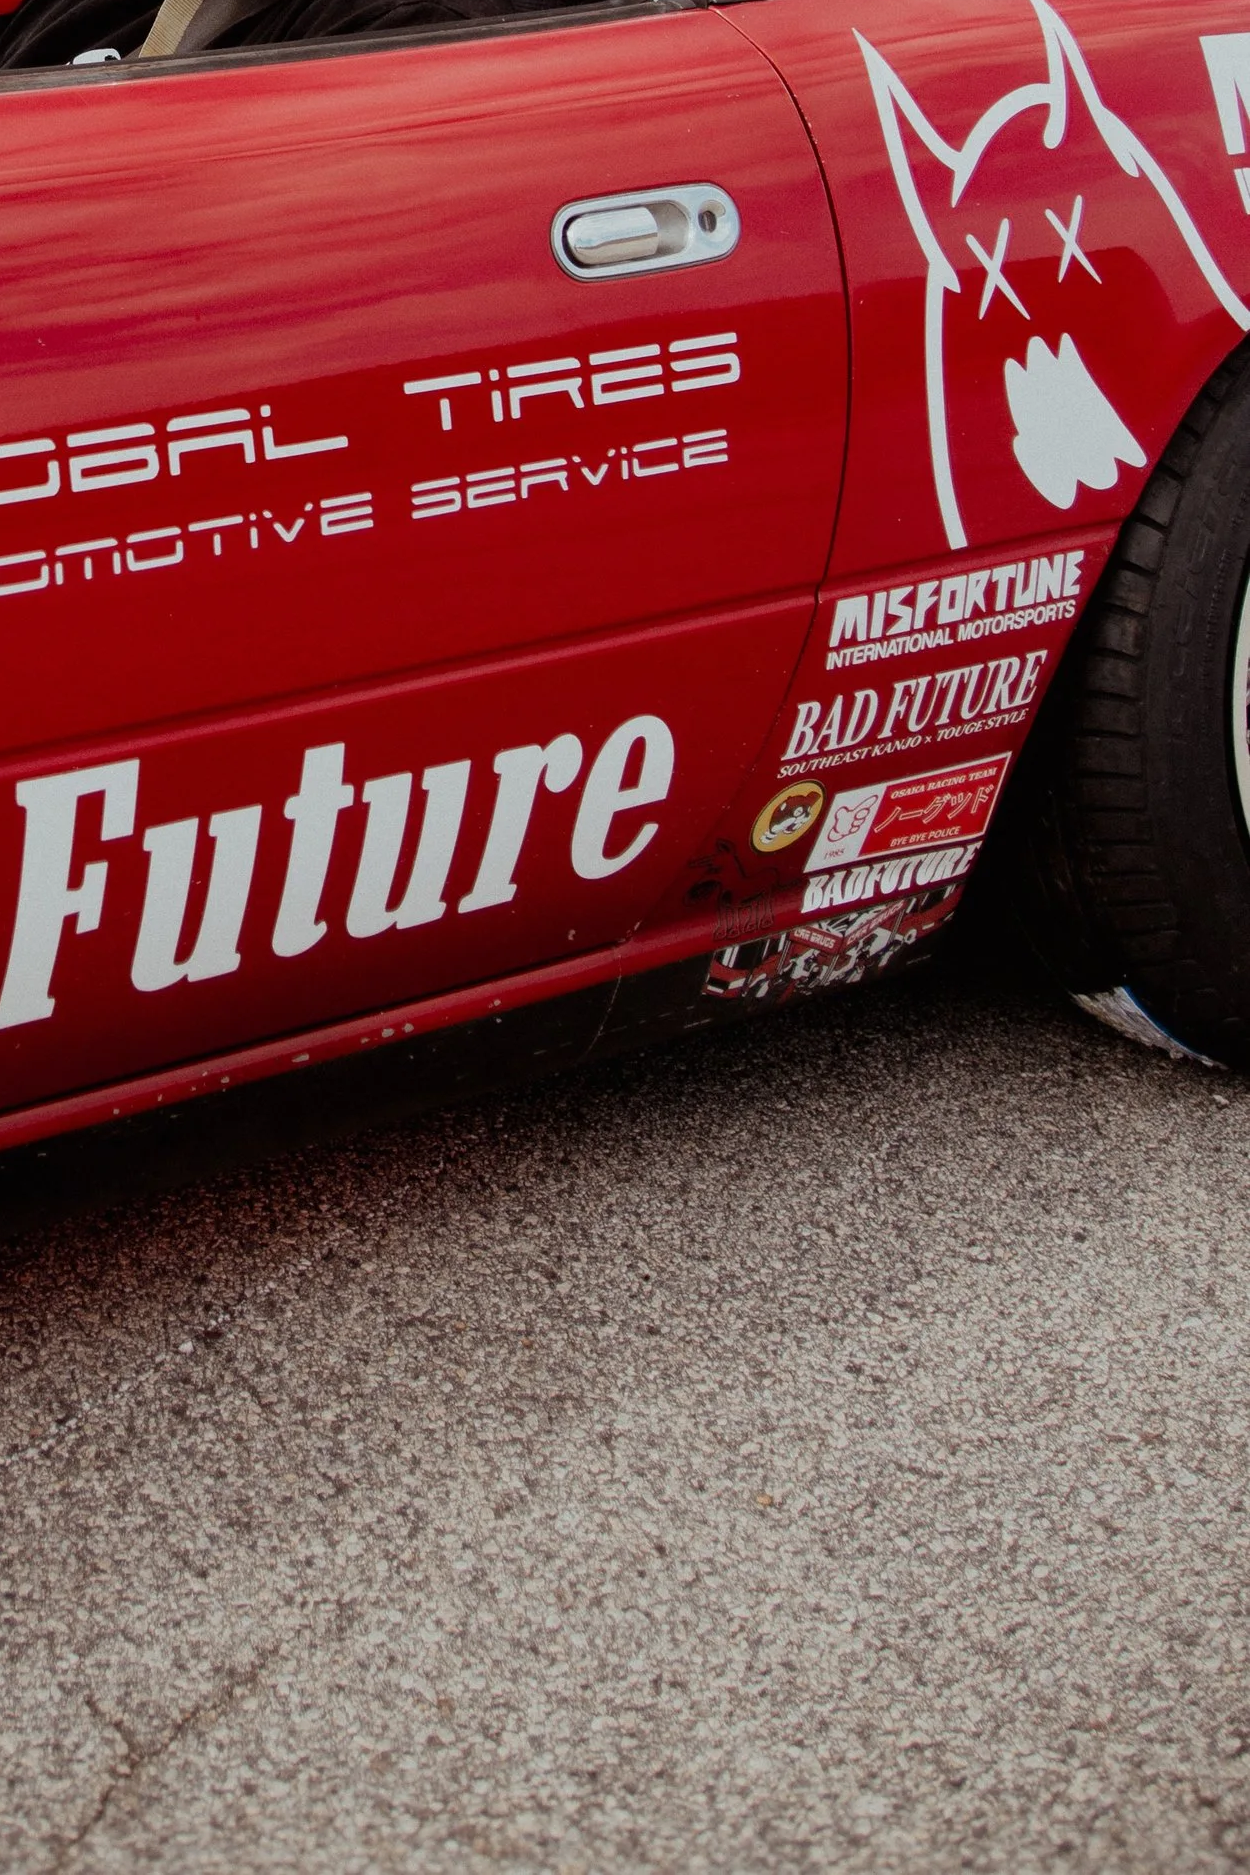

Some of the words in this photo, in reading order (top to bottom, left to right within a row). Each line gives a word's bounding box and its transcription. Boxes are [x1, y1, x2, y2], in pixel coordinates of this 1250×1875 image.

[404, 333, 740, 430] TIRES
[412, 430, 729, 519] SERVICE
[825, 627, 954, 671] INTERNATIONAL
[957, 600, 1076, 642] MOTORSPORTS
[828, 550, 1085, 648] MISFORTUNE
[781, 688, 879, 761] BAD
[877, 649, 1048, 740] FUTURE
[777, 746, 872, 779] SOUTHEAST
[871, 734, 923, 757] KANJO
[936, 720, 983, 742] TOUGE
[984, 708, 1029, 730] STYLE
[891, 785, 926, 800] OSAKA
[926, 775, 967, 792] RACING
[968, 767, 998, 782] TEAM
[890, 834, 908, 847] BYE
[909, 832, 928, 843] BYE
[928, 826, 962, 839] POLICE
[801, 841, 983, 914] BADFUTURE
